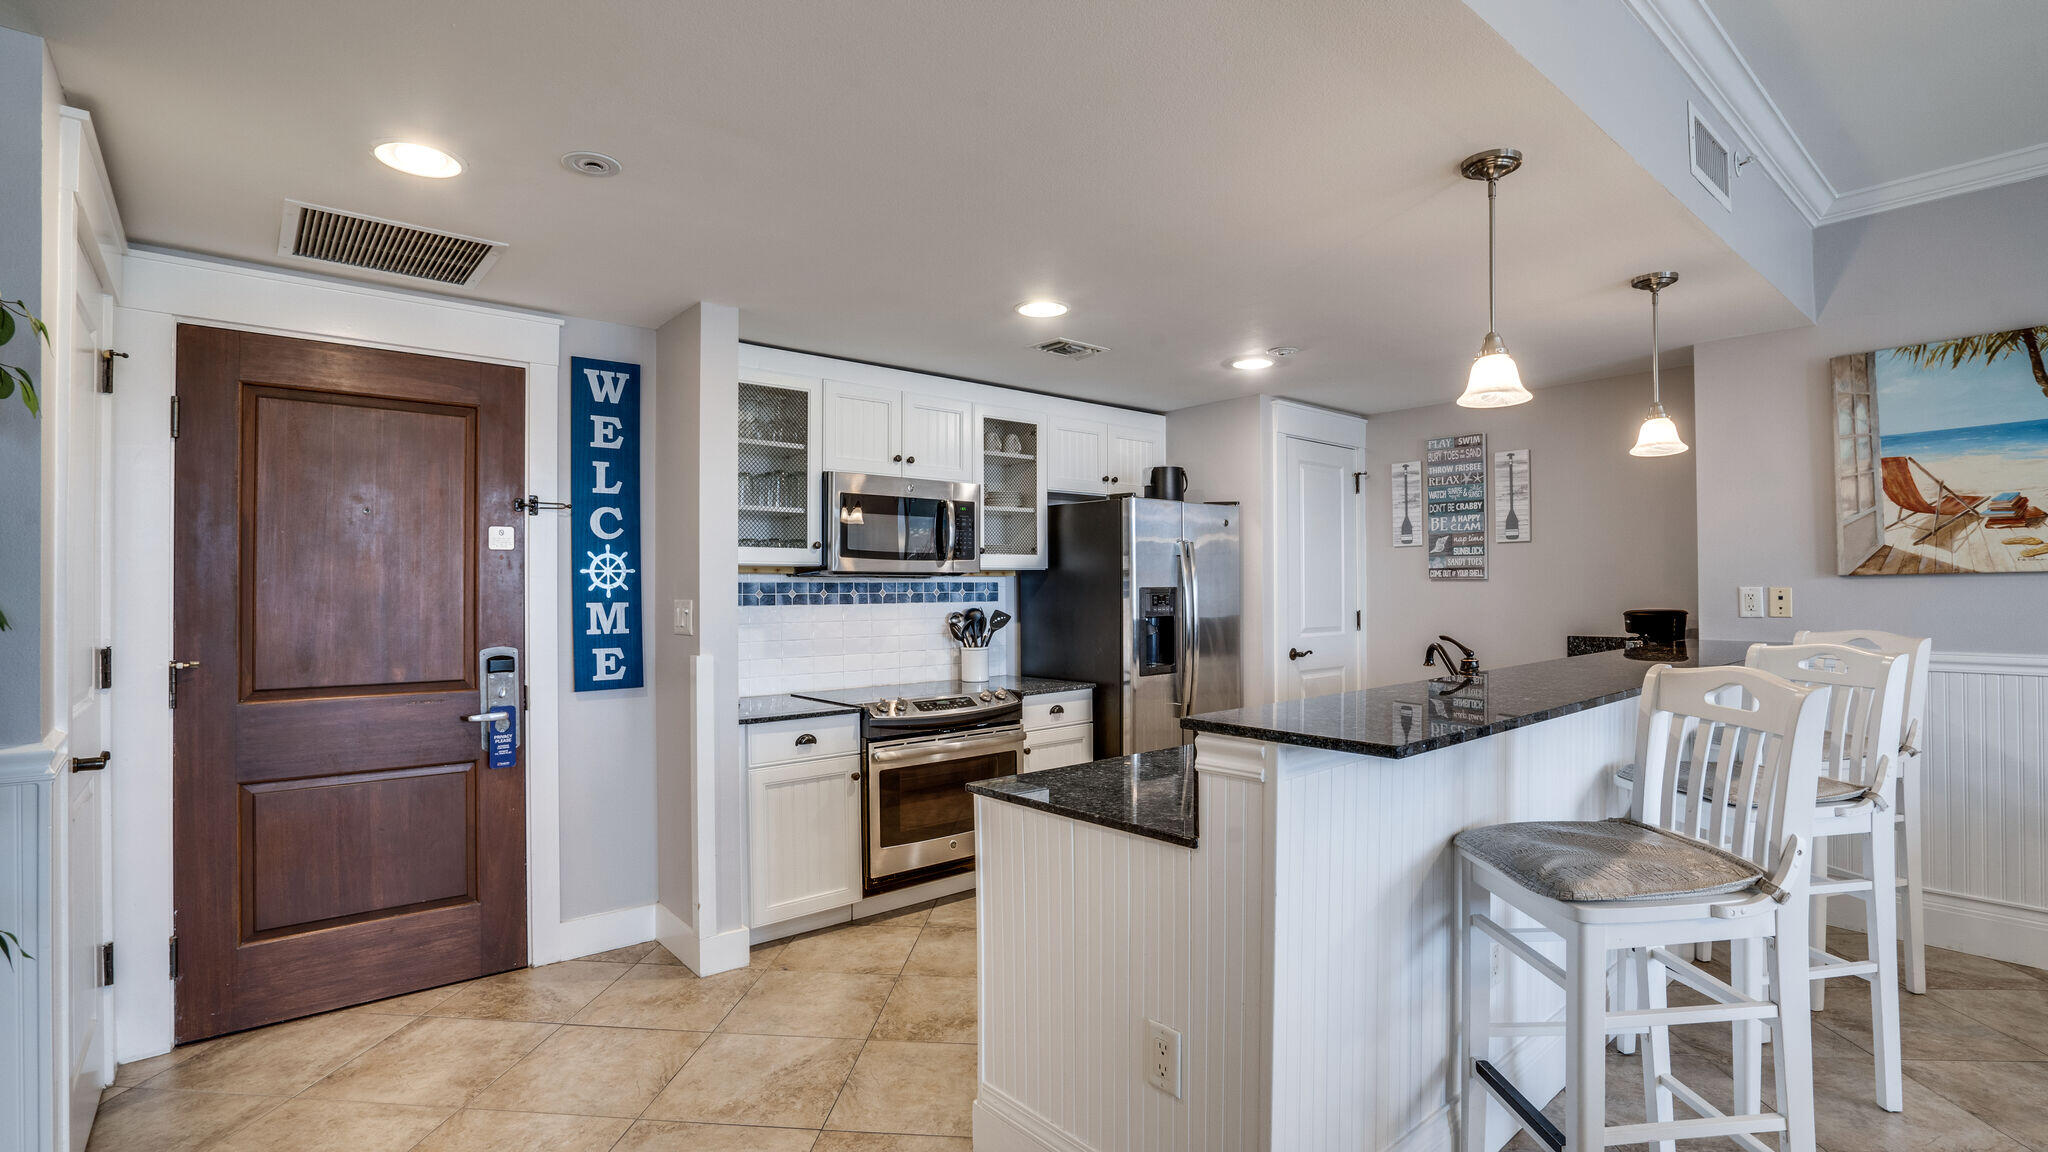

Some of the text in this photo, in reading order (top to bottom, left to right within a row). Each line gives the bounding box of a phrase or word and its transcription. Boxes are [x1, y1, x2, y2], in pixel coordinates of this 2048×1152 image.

[1428, 439, 1451, 449] PLAY
[1458, 436, 1480, 445] SWIM
[1428, 452, 1442, 462] BURY
[1444, 450, 1459, 461] TOES
[1465, 447, 1482, 458] SAND
[1428, 462, 1482, 475] THROW FRISBEE
[1428, 475, 1460, 486] RELAX
[1428, 490, 1447, 500] WATCH
[1429, 501, 1483, 513] DON'T BE CRABBY
[580, 368, 636, 682] WELCOME
[1431, 516, 1448, 531] BE
[1457, 514, 1481, 522] HAPPY
[1450, 522, 1481, 531] CLAM
[1453, 537, 1467, 546] nap
[1453, 547, 1484, 555] SUNBLOCK
[1447, 557, 1483, 566] SANDY TOES
